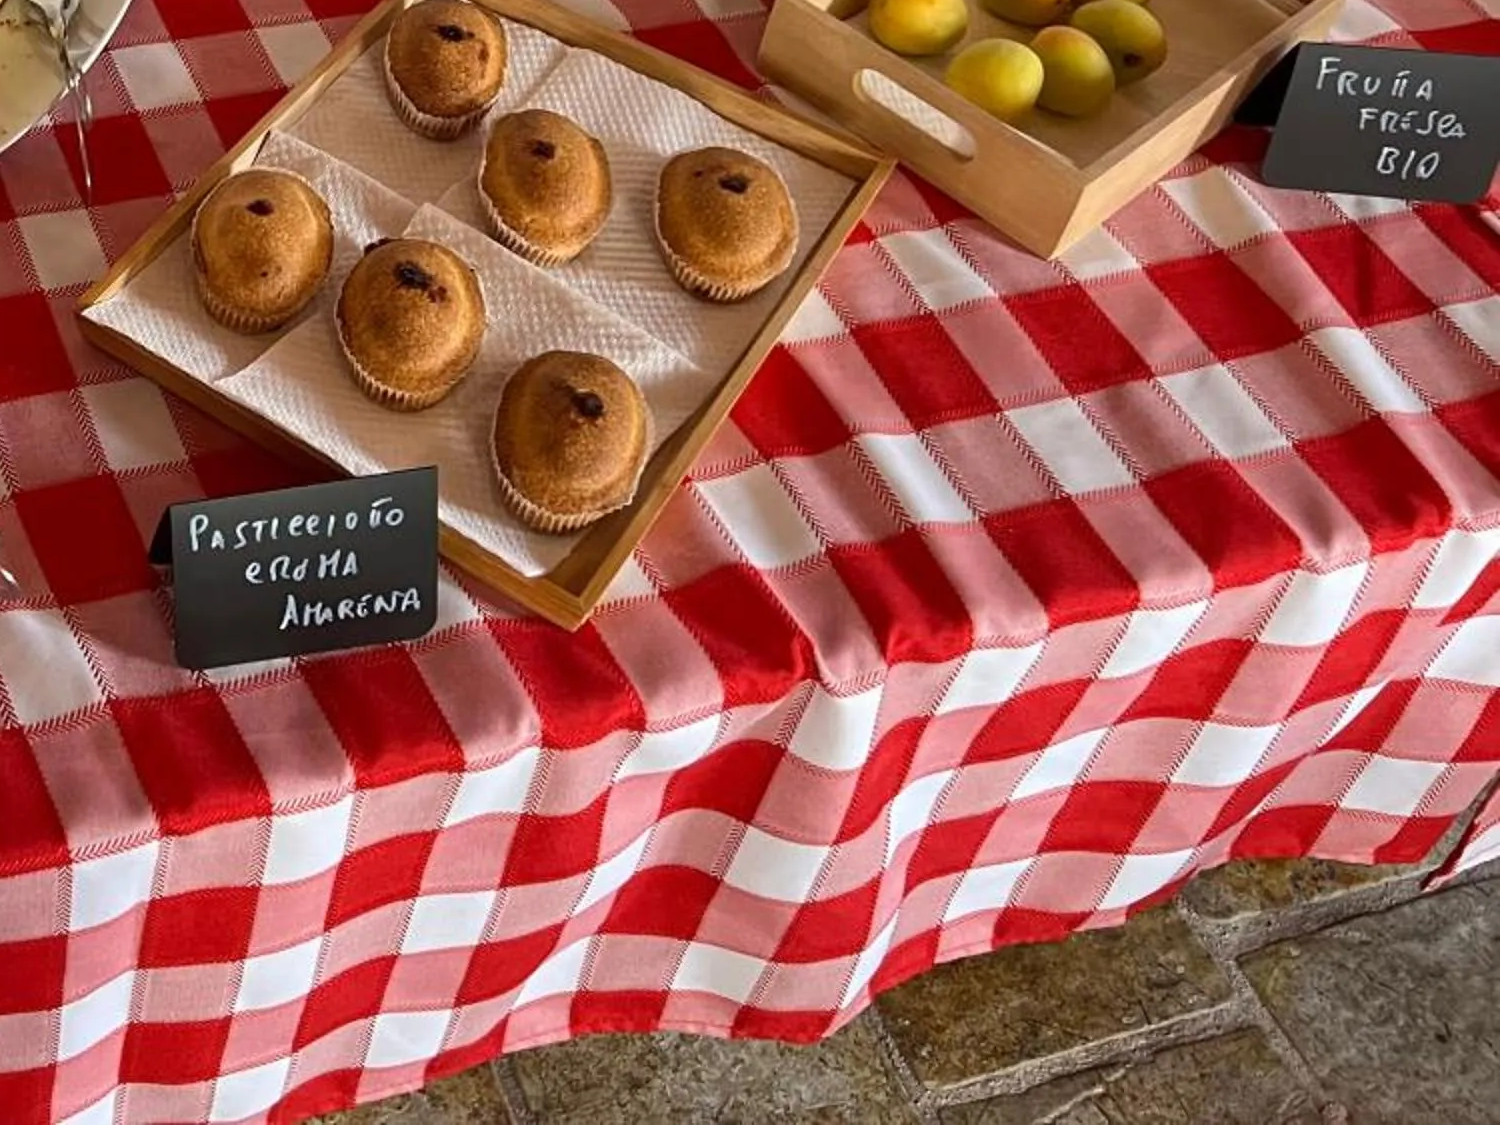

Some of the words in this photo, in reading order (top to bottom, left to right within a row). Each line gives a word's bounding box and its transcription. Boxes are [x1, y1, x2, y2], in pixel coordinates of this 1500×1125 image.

[1315, 56, 1433, 102] FRUTTA
[1358, 107, 1467, 139] FRESCA
[1376, 146, 1440, 180] BIO
[278, 587, 422, 631] AMARENA
